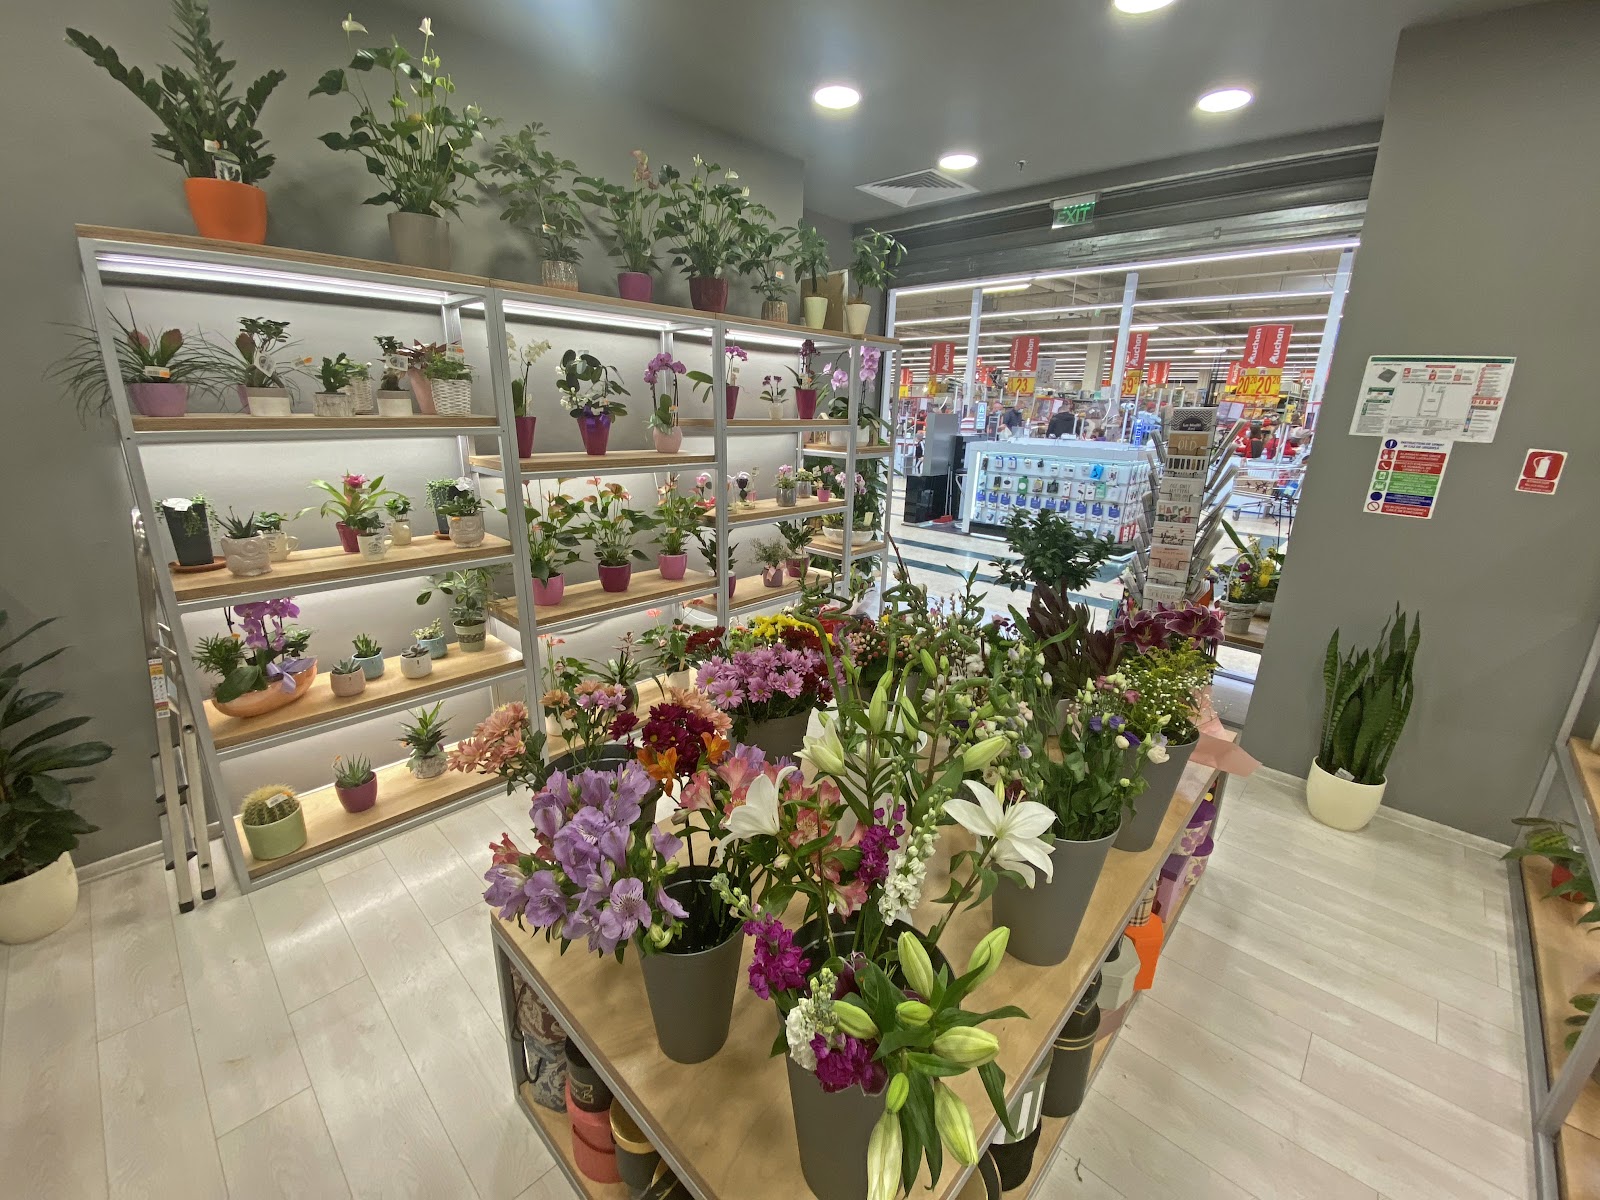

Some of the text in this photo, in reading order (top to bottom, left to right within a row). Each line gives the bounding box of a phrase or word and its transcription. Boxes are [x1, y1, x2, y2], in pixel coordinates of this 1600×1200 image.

[1056, 207, 1091, 224] EXIT
[942, 344, 951, 371] Auchan
[1024, 338, 1035, 368] Auchan
[1130, 333, 1143, 367] Auchan
[1247, 328, 1262, 364] Auchan
[1269, 327, 1285, 365] Auchan
[1255, 376, 1272, 395] 20
[1177, 440, 1197, 451] OLD
[1158, 504, 1192, 517] HAPPY
